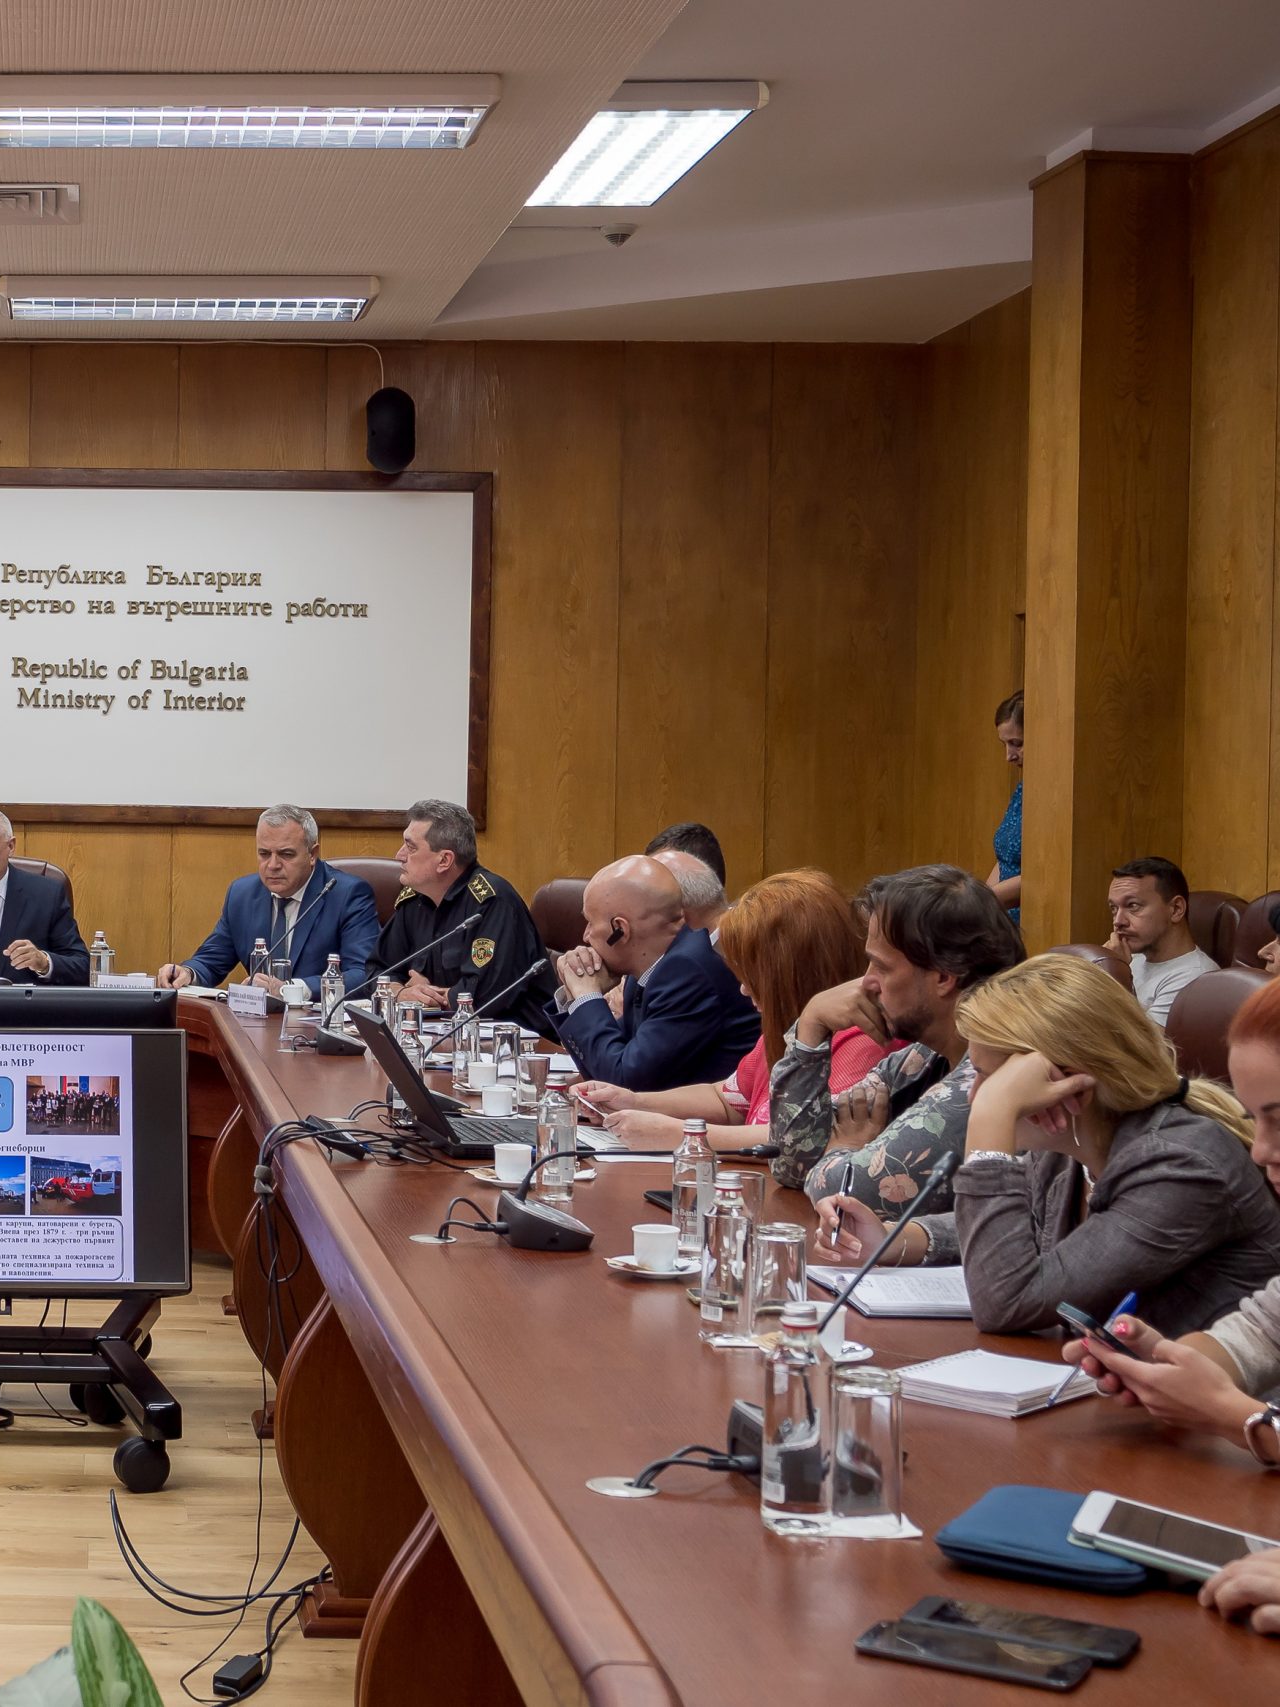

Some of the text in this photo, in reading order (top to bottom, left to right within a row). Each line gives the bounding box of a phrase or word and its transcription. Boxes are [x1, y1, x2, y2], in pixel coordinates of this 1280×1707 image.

[1, 563, 262, 592] Република България
[88, 600, 116, 614] на
[127, 600, 272, 622] вътрешните
[285, 597, 369, 623] работи
[11, 657, 249, 687] Republic of Bulgaria
[17, 687, 246, 714] Ministry of Interior
[10, 1058, 35, 1067] МВР
